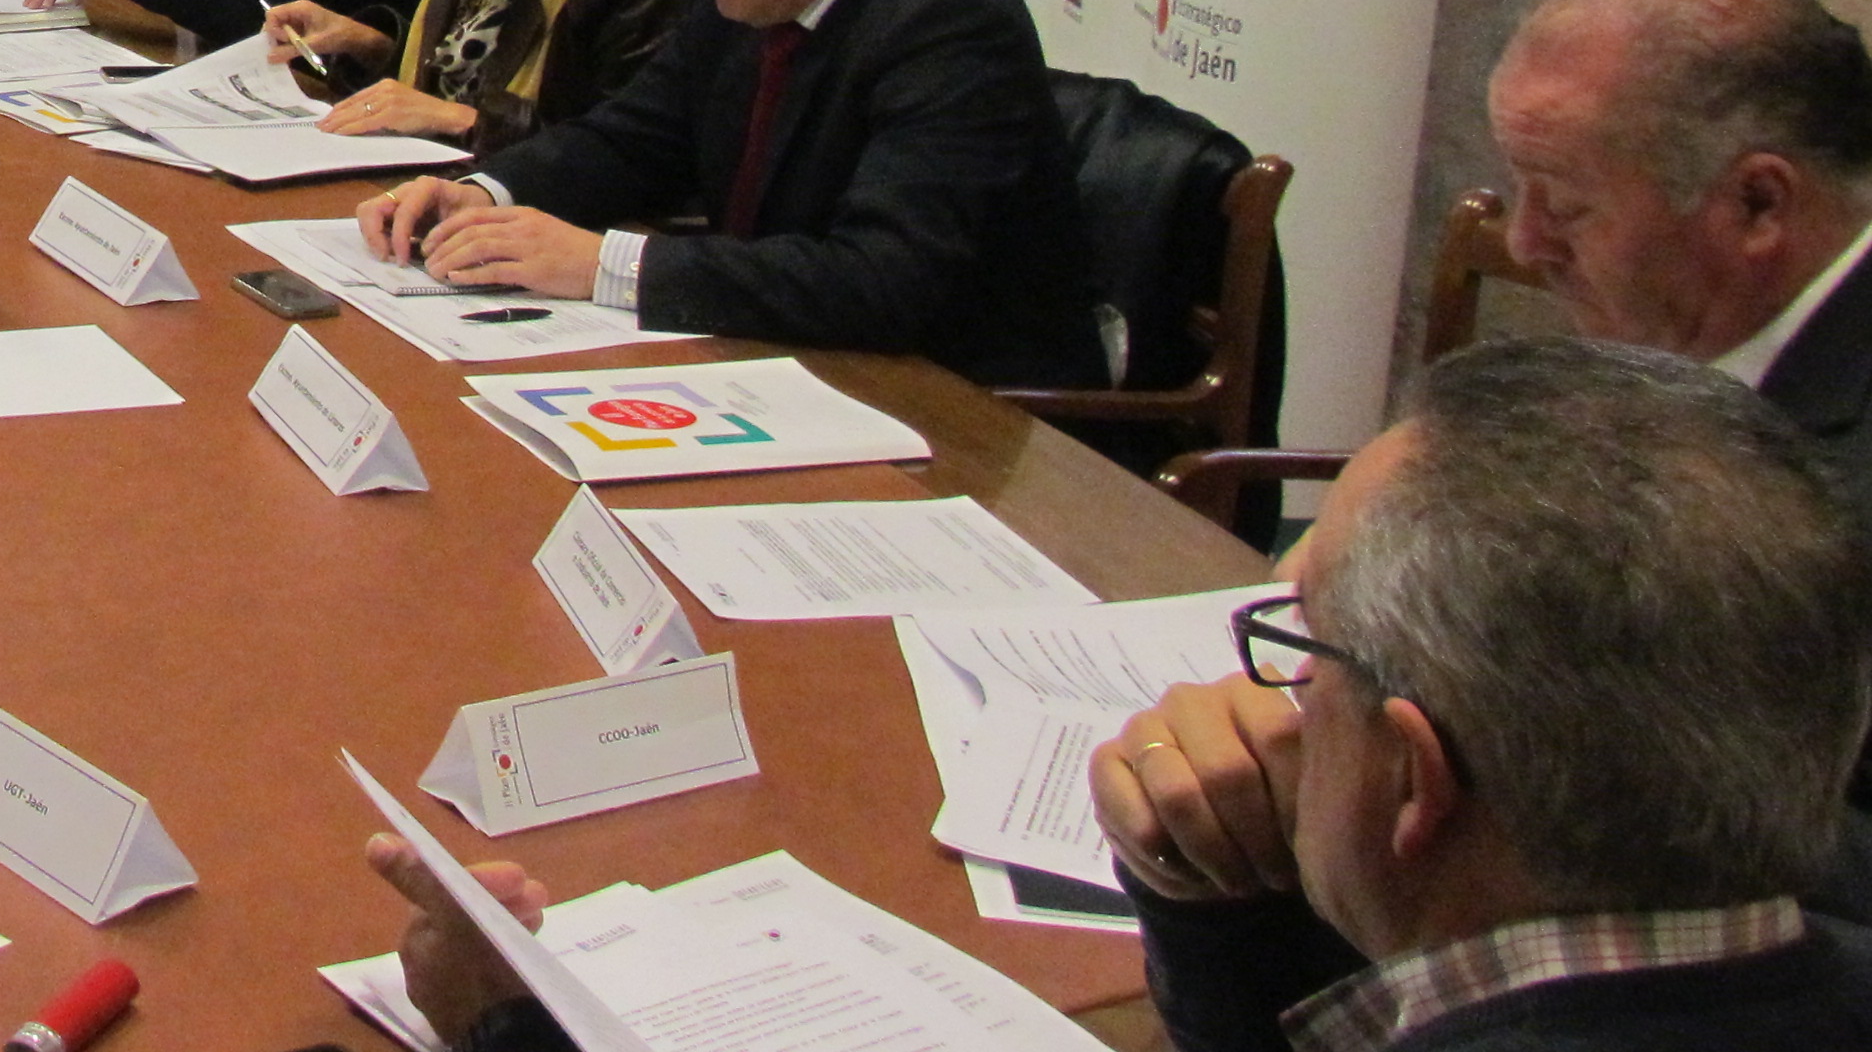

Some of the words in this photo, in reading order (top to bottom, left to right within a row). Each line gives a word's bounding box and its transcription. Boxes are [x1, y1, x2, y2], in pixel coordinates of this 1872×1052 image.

[1190, 38, 1236, 84] Jaén
[598, 722, 661, 745] CCOO-Jaén
[2, 778, 50, 817] UGT-Jaén
